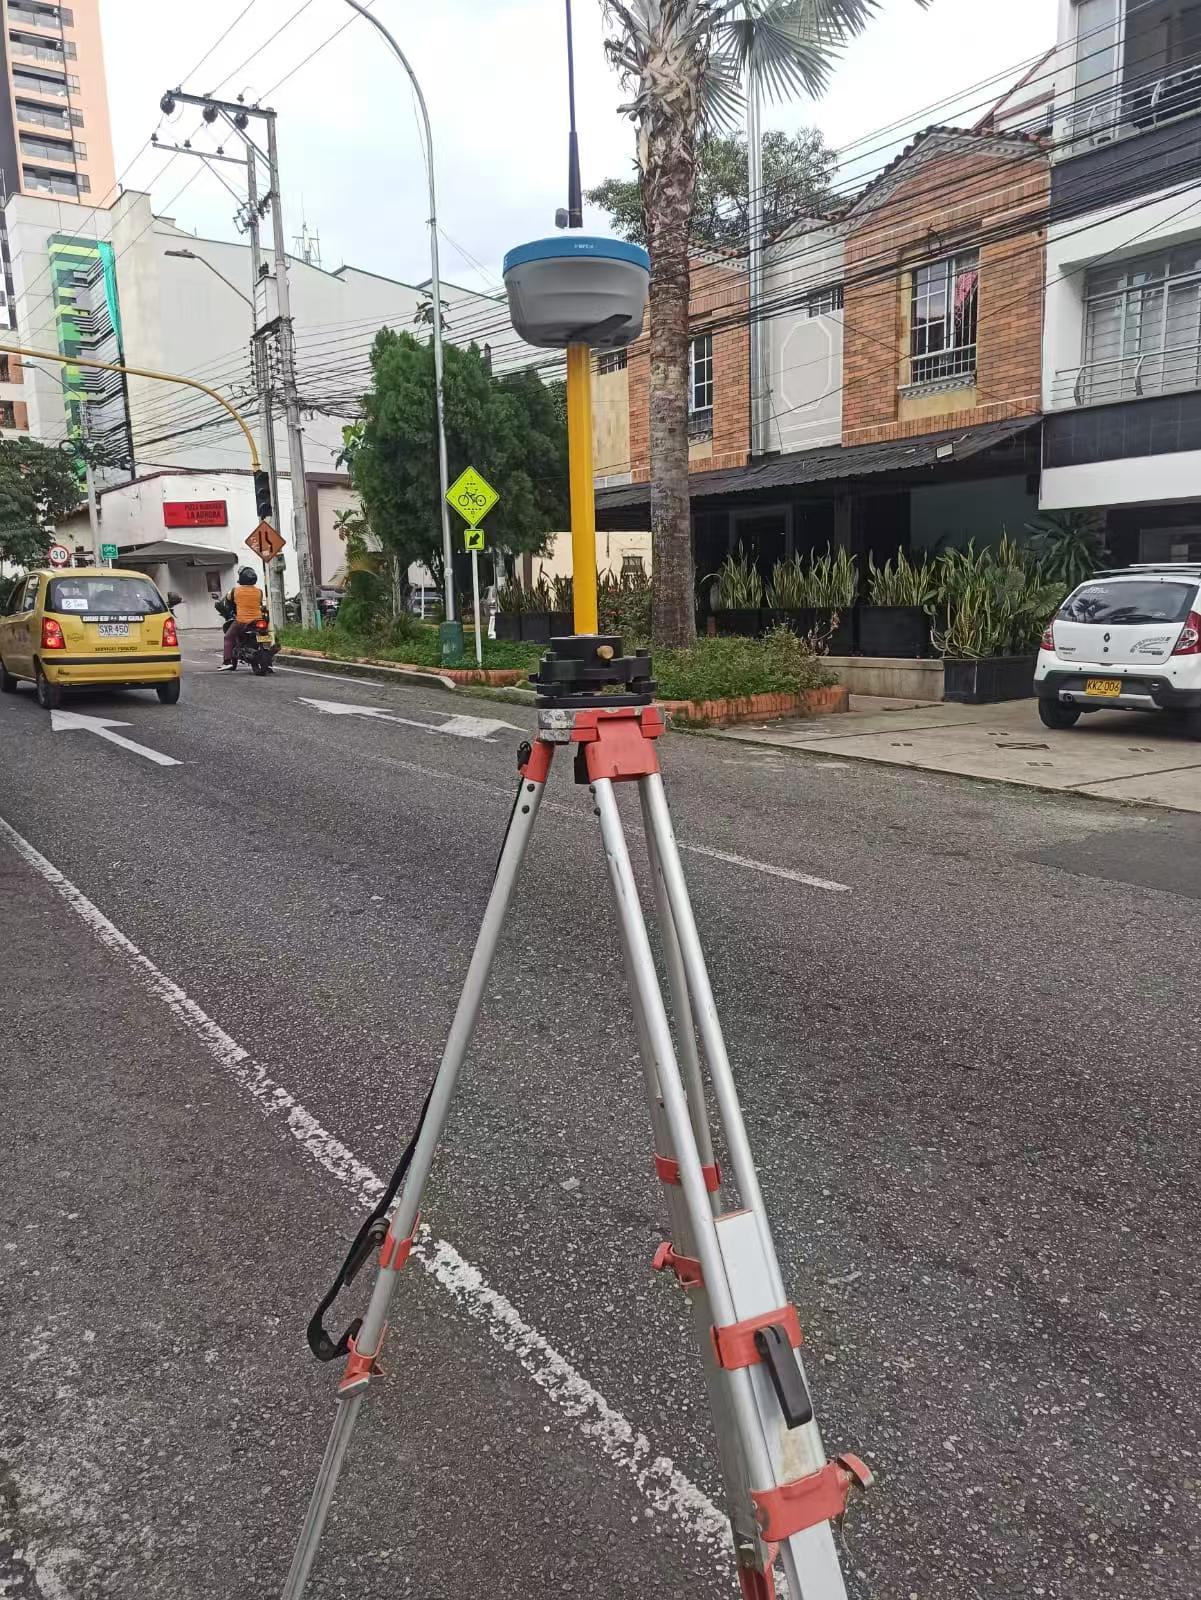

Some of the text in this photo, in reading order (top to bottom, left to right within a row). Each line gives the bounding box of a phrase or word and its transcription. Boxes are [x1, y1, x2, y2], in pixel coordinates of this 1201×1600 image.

[53, 551, 66, 559] 30
[99, 624, 114, 634] SXR
[1087, 680, 1120, 692] KKZ 006
